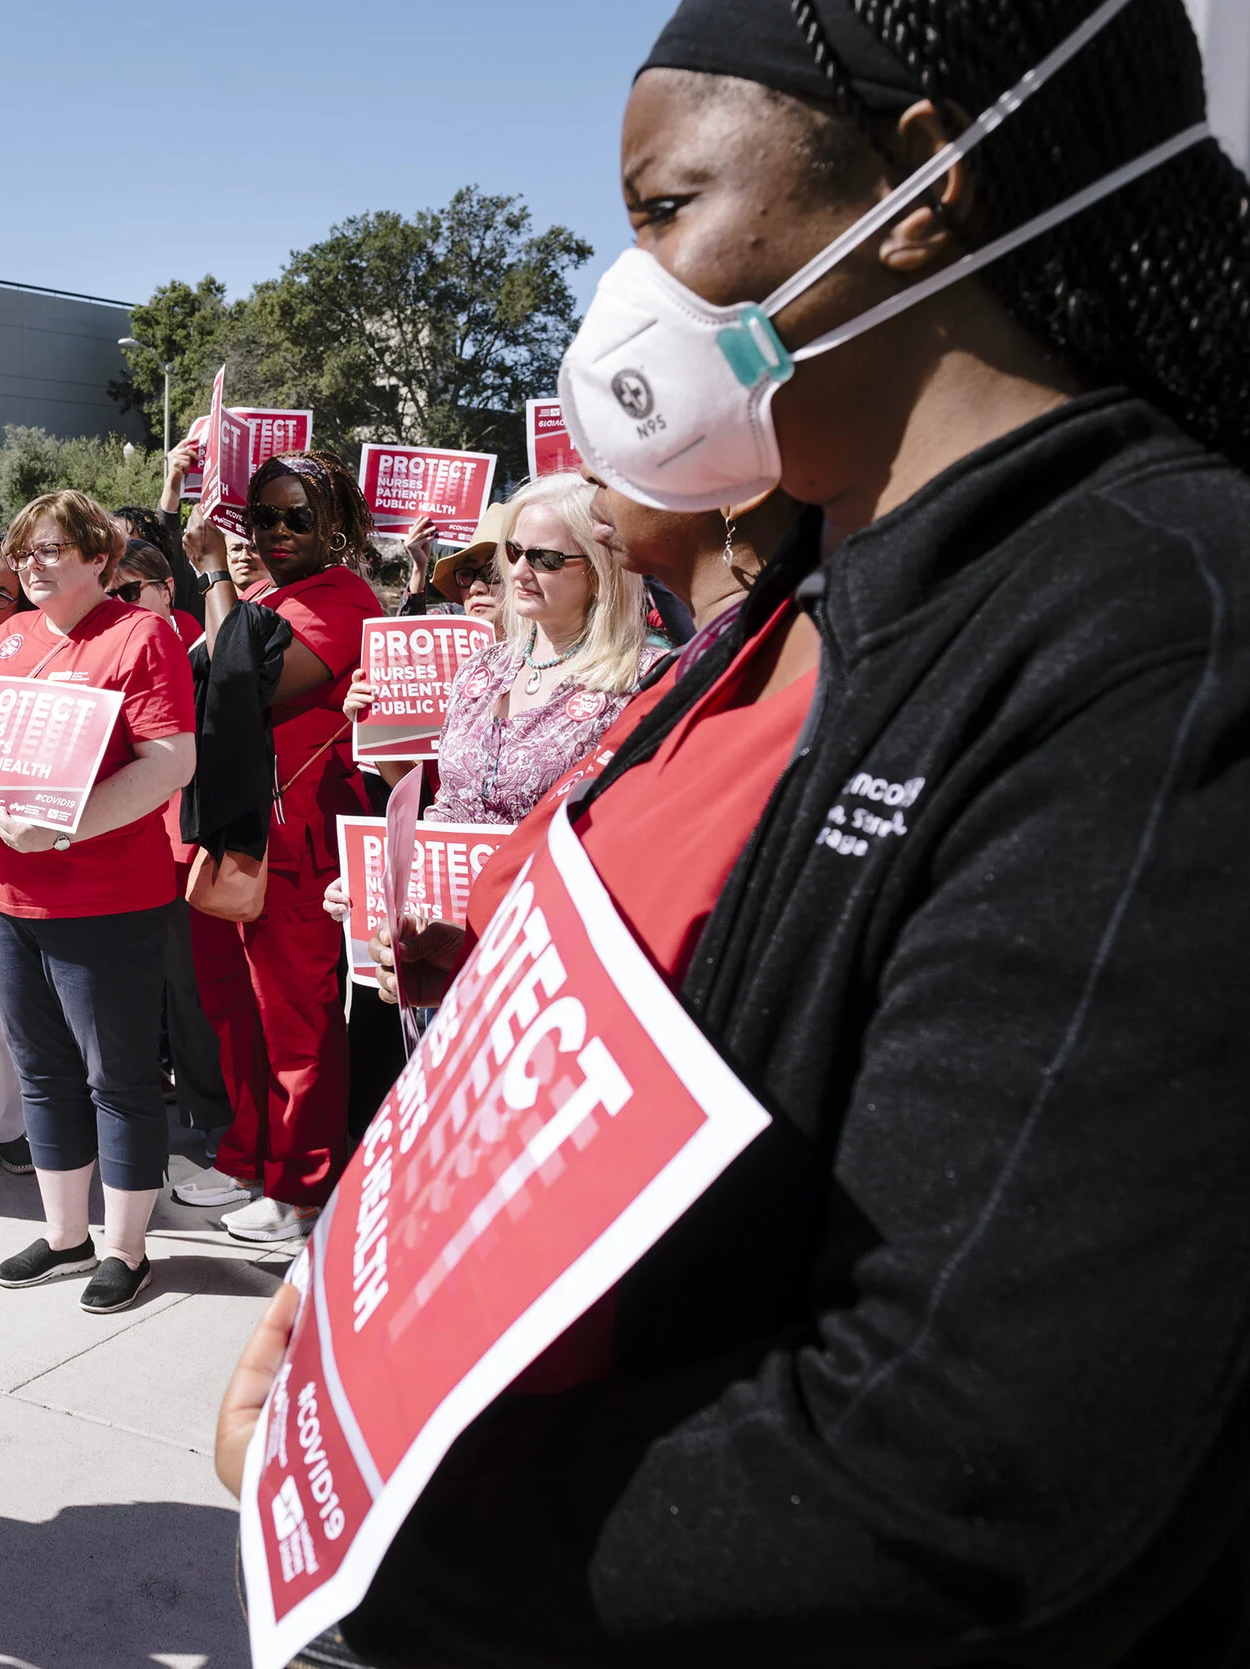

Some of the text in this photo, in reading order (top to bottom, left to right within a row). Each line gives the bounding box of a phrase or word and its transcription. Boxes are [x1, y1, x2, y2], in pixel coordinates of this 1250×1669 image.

[249, 418, 297, 437] TECT
[637, 414, 667, 440] N95
[379, 455, 477, 479] PROTECT
[377, 478, 423, 490] NURSES
[376, 488, 430, 501] PATIENTS
[375, 498, 456, 515] PUBLIC HEALTH
[370, 628, 490, 657] PROTECT
[370, 664, 438, 681] NURSES
[371, 681, 452, 698] PATIENTS
[371, 699, 435, 715] PUBLIC
[35, 793, 76, 808] #COVID19
[353, 1158, 394, 1334] HEALTH
[297, 1381, 346, 1541] #COVID19
